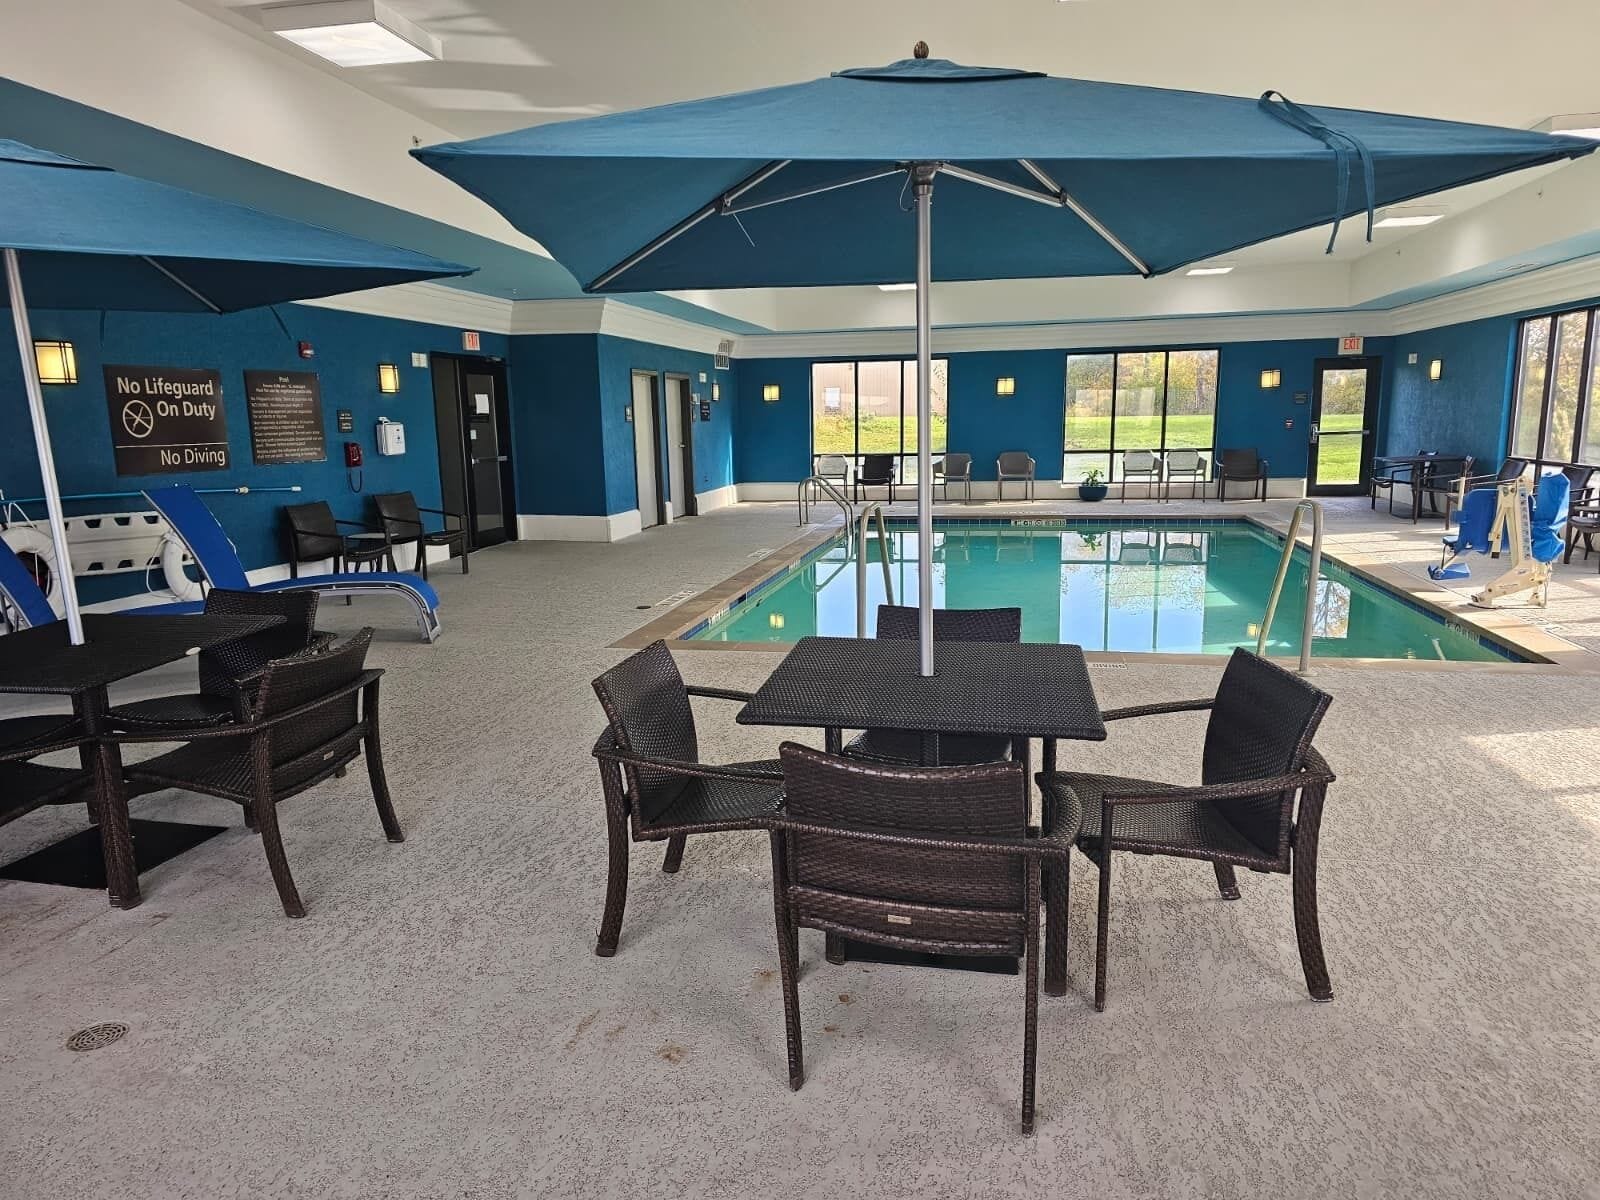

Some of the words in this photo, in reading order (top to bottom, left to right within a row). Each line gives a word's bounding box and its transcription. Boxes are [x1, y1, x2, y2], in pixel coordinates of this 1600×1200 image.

[1343, 338, 1361, 350] EXIT
[117, 377, 141, 394] No
[144, 377, 214, 399] Lifeguard
[156, 401, 179, 417] On
[182, 401, 216, 421] Duty
[160, 449, 181, 466] No
[184, 447, 226, 466] Diving
